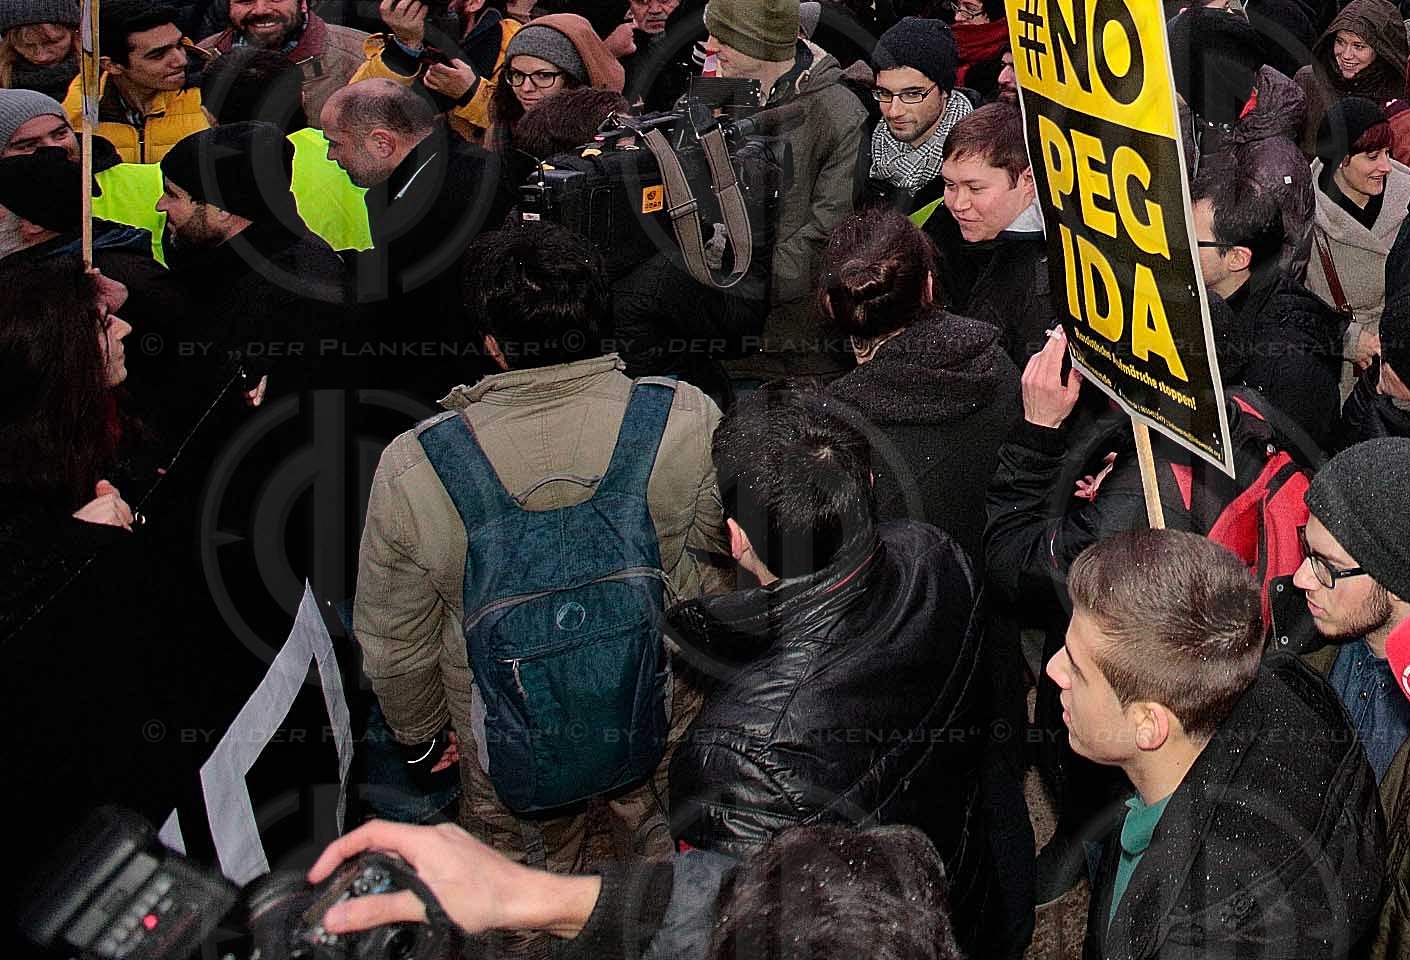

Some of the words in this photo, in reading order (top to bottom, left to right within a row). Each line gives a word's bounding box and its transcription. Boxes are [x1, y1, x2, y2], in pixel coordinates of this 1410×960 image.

[1038, 113, 1172, 262] PEG
[1059, 221, 1190, 384] IDA
[1158, 380, 1197, 411] stoppen!
